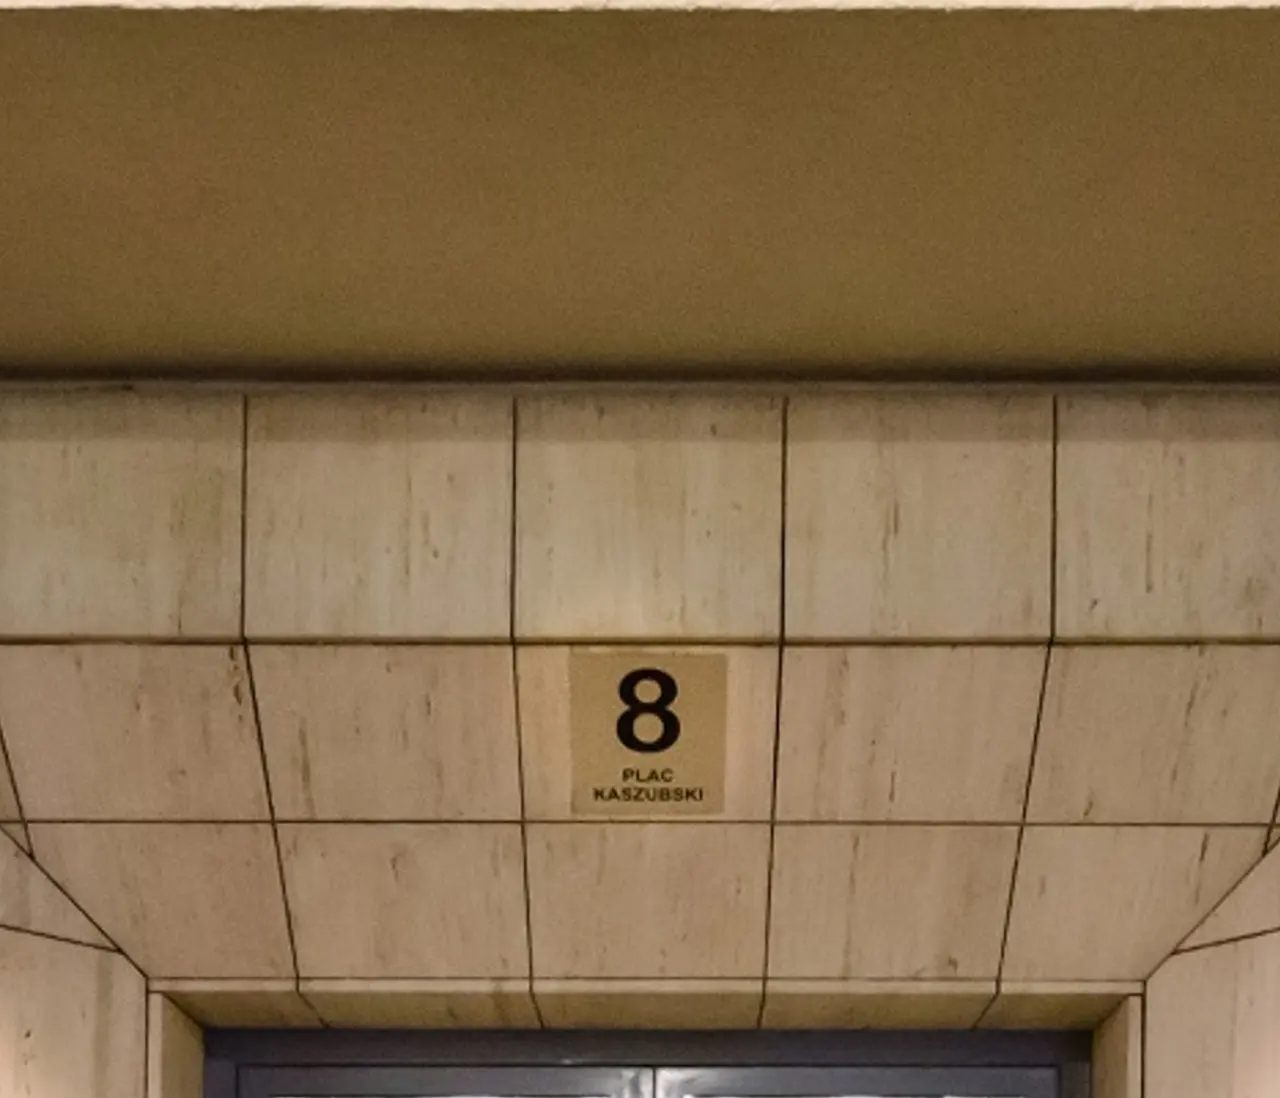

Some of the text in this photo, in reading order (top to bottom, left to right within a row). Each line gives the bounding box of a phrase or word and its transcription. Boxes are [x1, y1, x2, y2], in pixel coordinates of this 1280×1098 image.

[616, 667, 681, 754] 8
[622, 768, 674, 783] PLAC
[593, 787, 704, 802] KASZUBSKI
